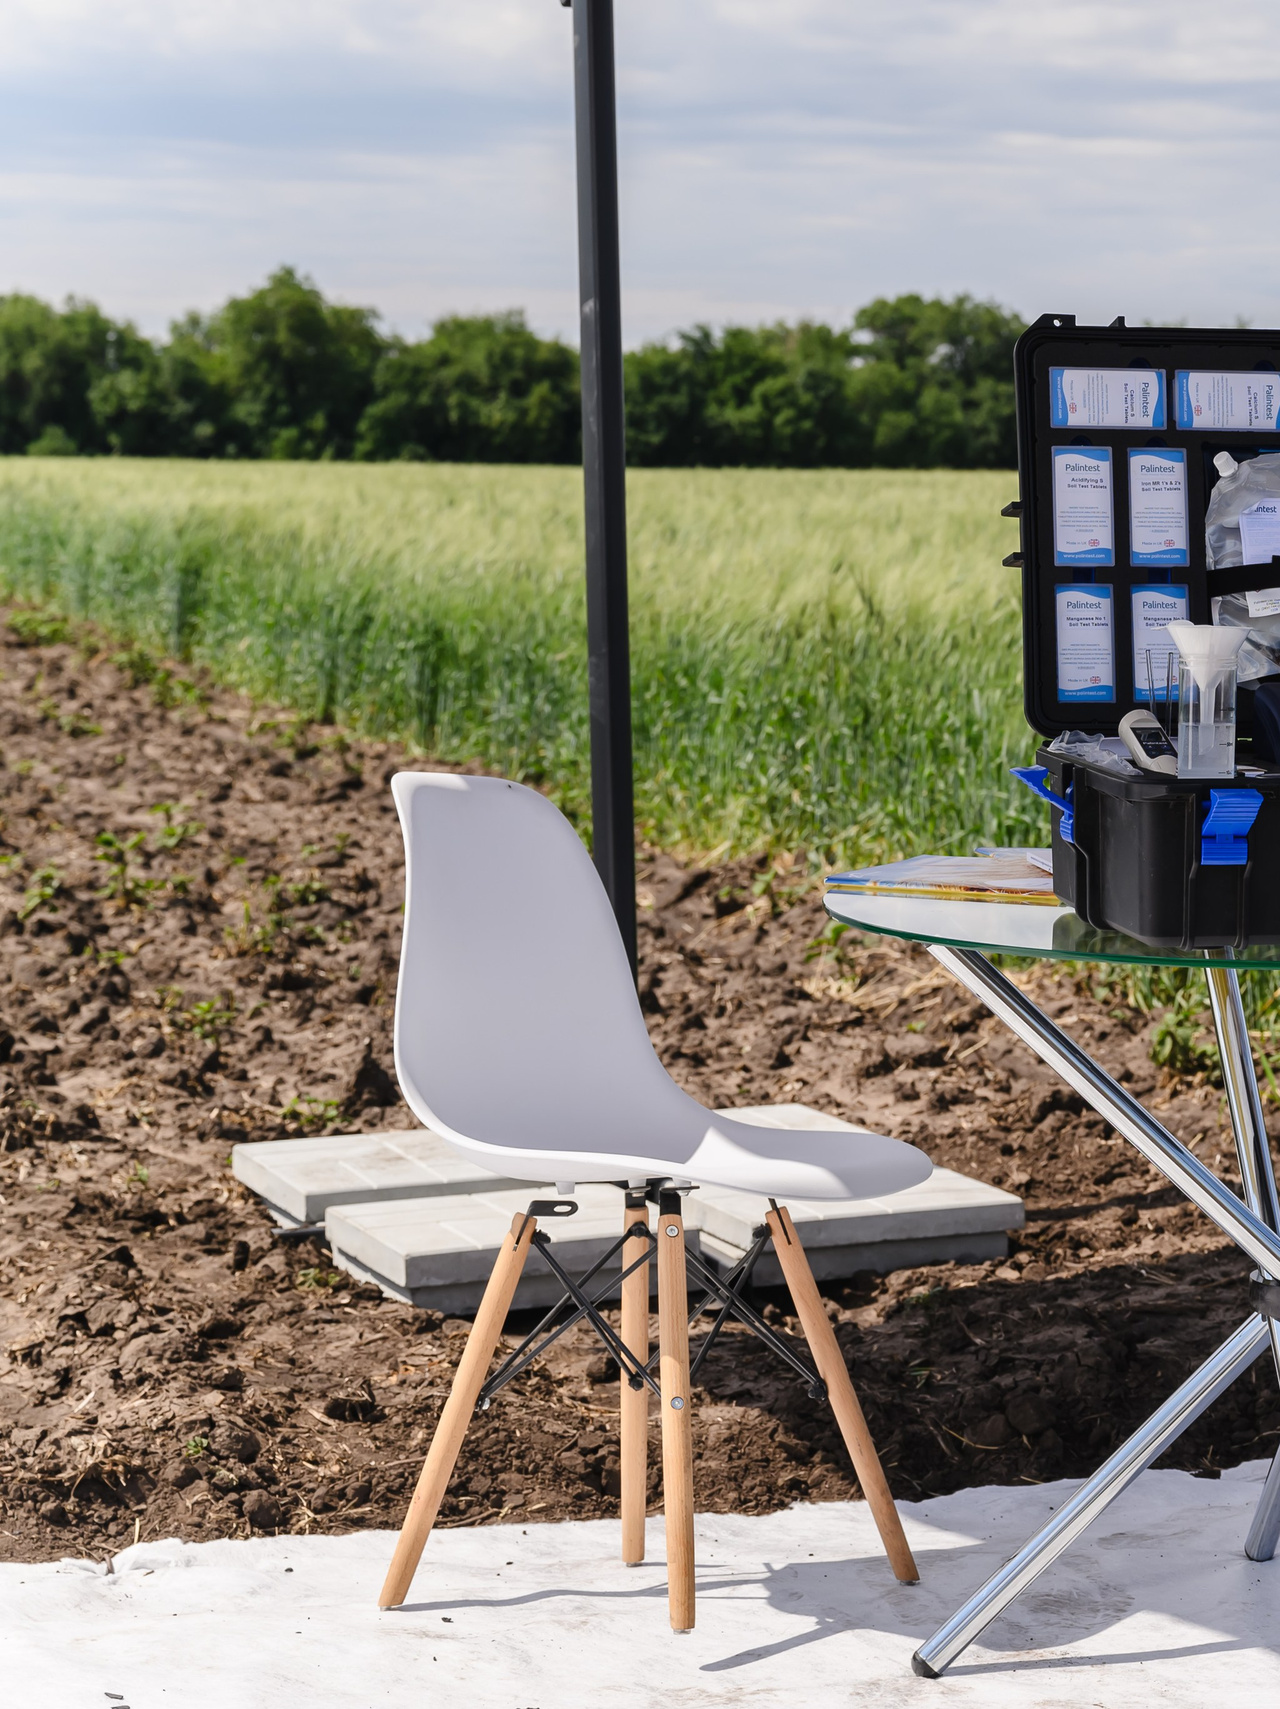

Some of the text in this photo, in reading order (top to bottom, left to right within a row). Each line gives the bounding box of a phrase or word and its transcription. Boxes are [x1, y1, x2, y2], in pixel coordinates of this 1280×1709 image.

[1141, 382, 1150, 418] Palintest
[1265, 385, 1273, 420] Palintest
[1065, 463, 1101, 472] Palintest
[1140, 465, 1175, 473] Palintest
[1066, 601, 1102, 609] Palintest
[1142, 601, 1177, 609] Palintest
